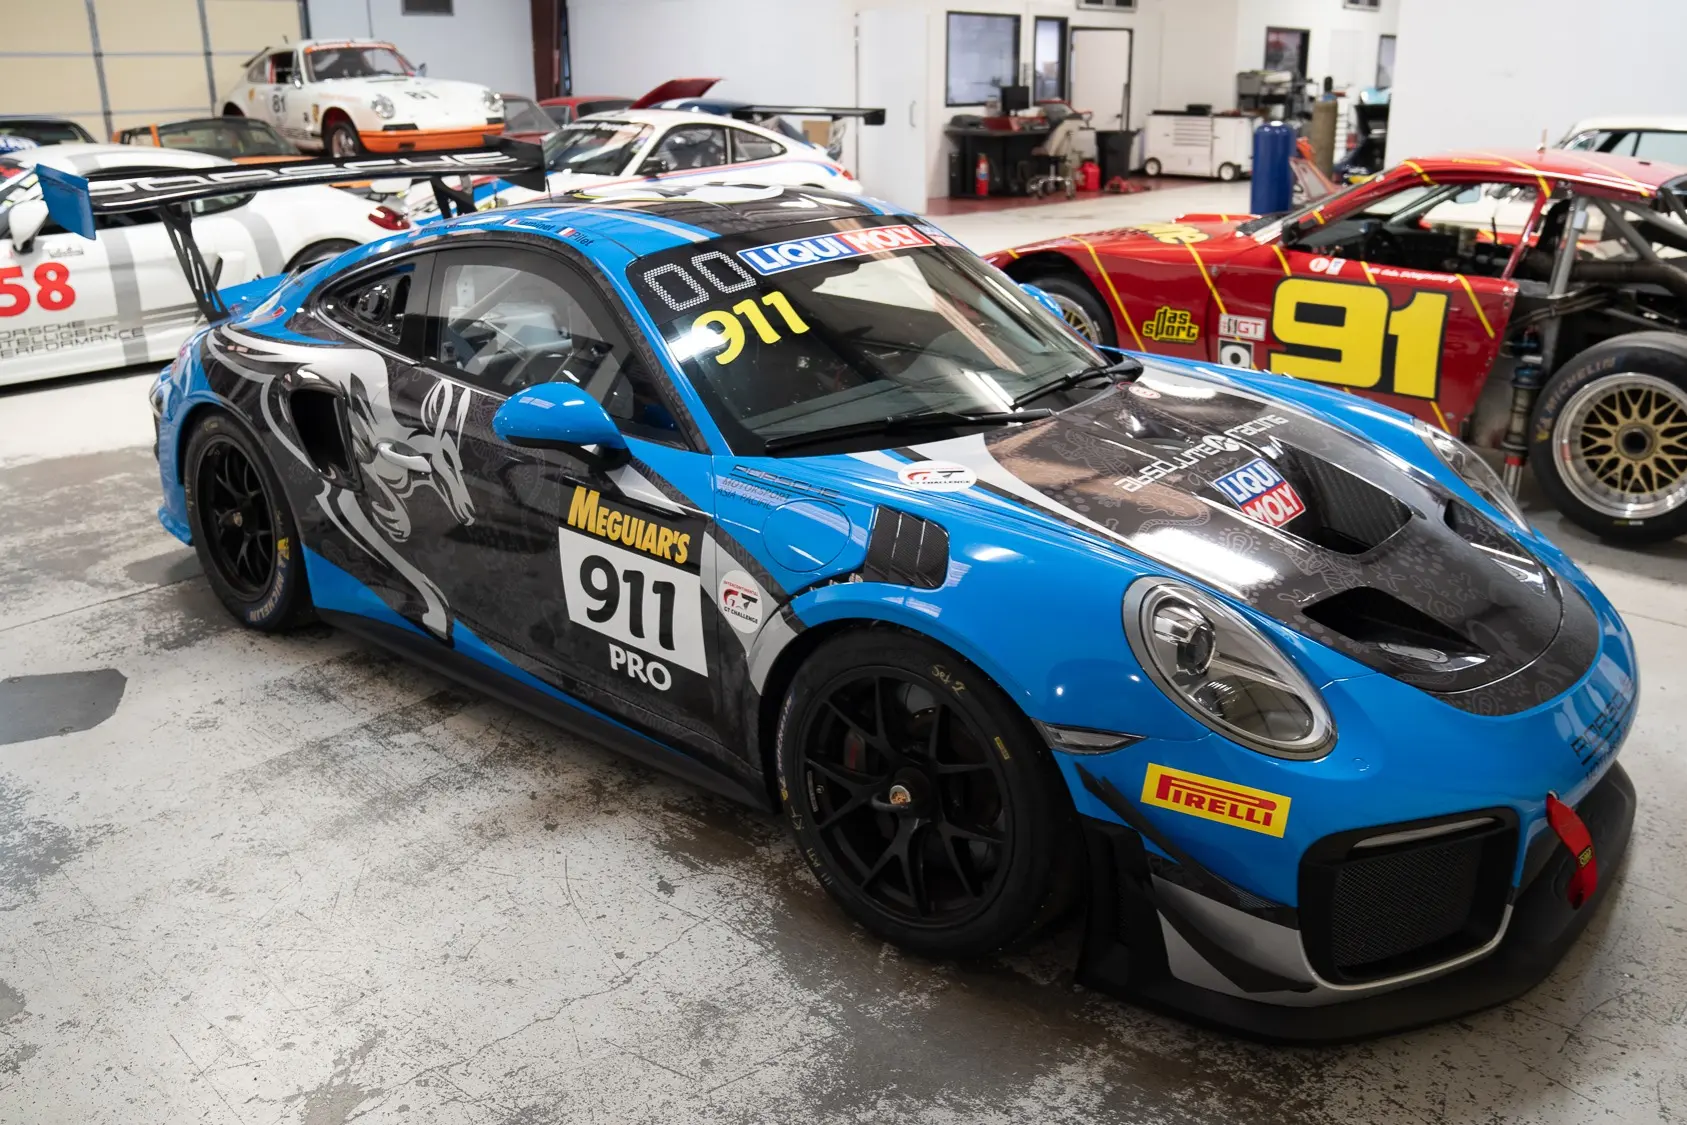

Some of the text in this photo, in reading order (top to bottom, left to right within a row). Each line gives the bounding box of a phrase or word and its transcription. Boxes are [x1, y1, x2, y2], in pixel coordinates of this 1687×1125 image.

[568, 231, 595, 247] Pilet
[748, 236, 852, 270] LIQUI
[843, 226, 922, 253] MOLY
[0, 262, 76, 317] 58
[691, 290, 810, 365] 911
[1270, 278, 1448, 399] 91
[716, 488, 773, 511] ASIA PACIFIC
[722, 477, 792, 502] MOTORSPORT
[1220, 461, 1283, 504] LIQUI
[1244, 483, 1301, 527] MOLY
[567, 485, 690, 564] MEGUIAR'S
[248, 571, 285, 622] MICHELIN
[579, 554, 676, 651] 911
[731, 609, 759, 624] CHALLENGE
[609, 642, 672, 692] PRO
[1156, 773, 1277, 827] PIRELLI
